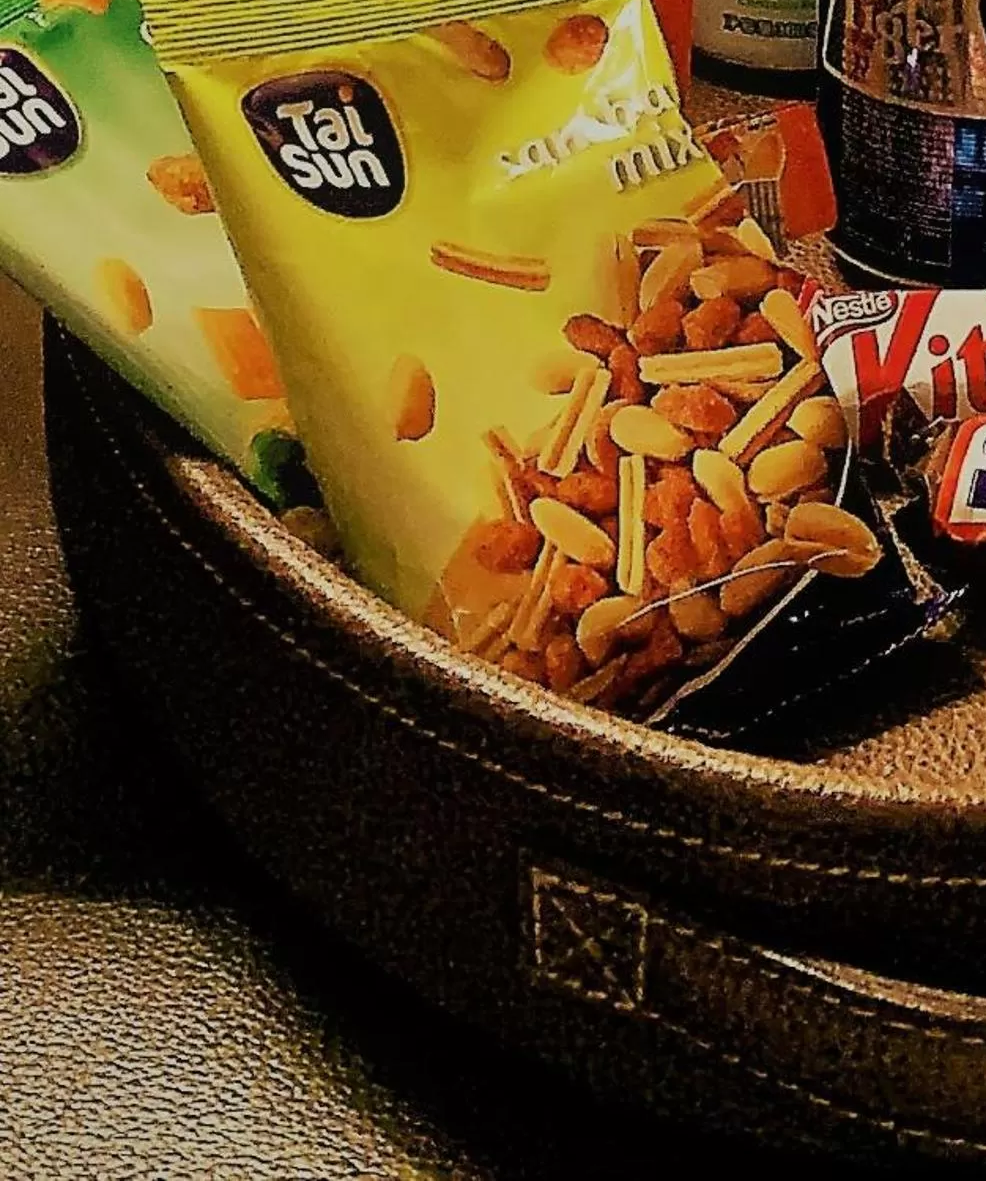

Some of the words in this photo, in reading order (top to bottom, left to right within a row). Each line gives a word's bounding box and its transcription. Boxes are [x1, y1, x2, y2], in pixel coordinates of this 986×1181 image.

[0, 96, 68, 160] un
[275, 84, 375, 152] Tai
[609, 122, 706, 193] mix
